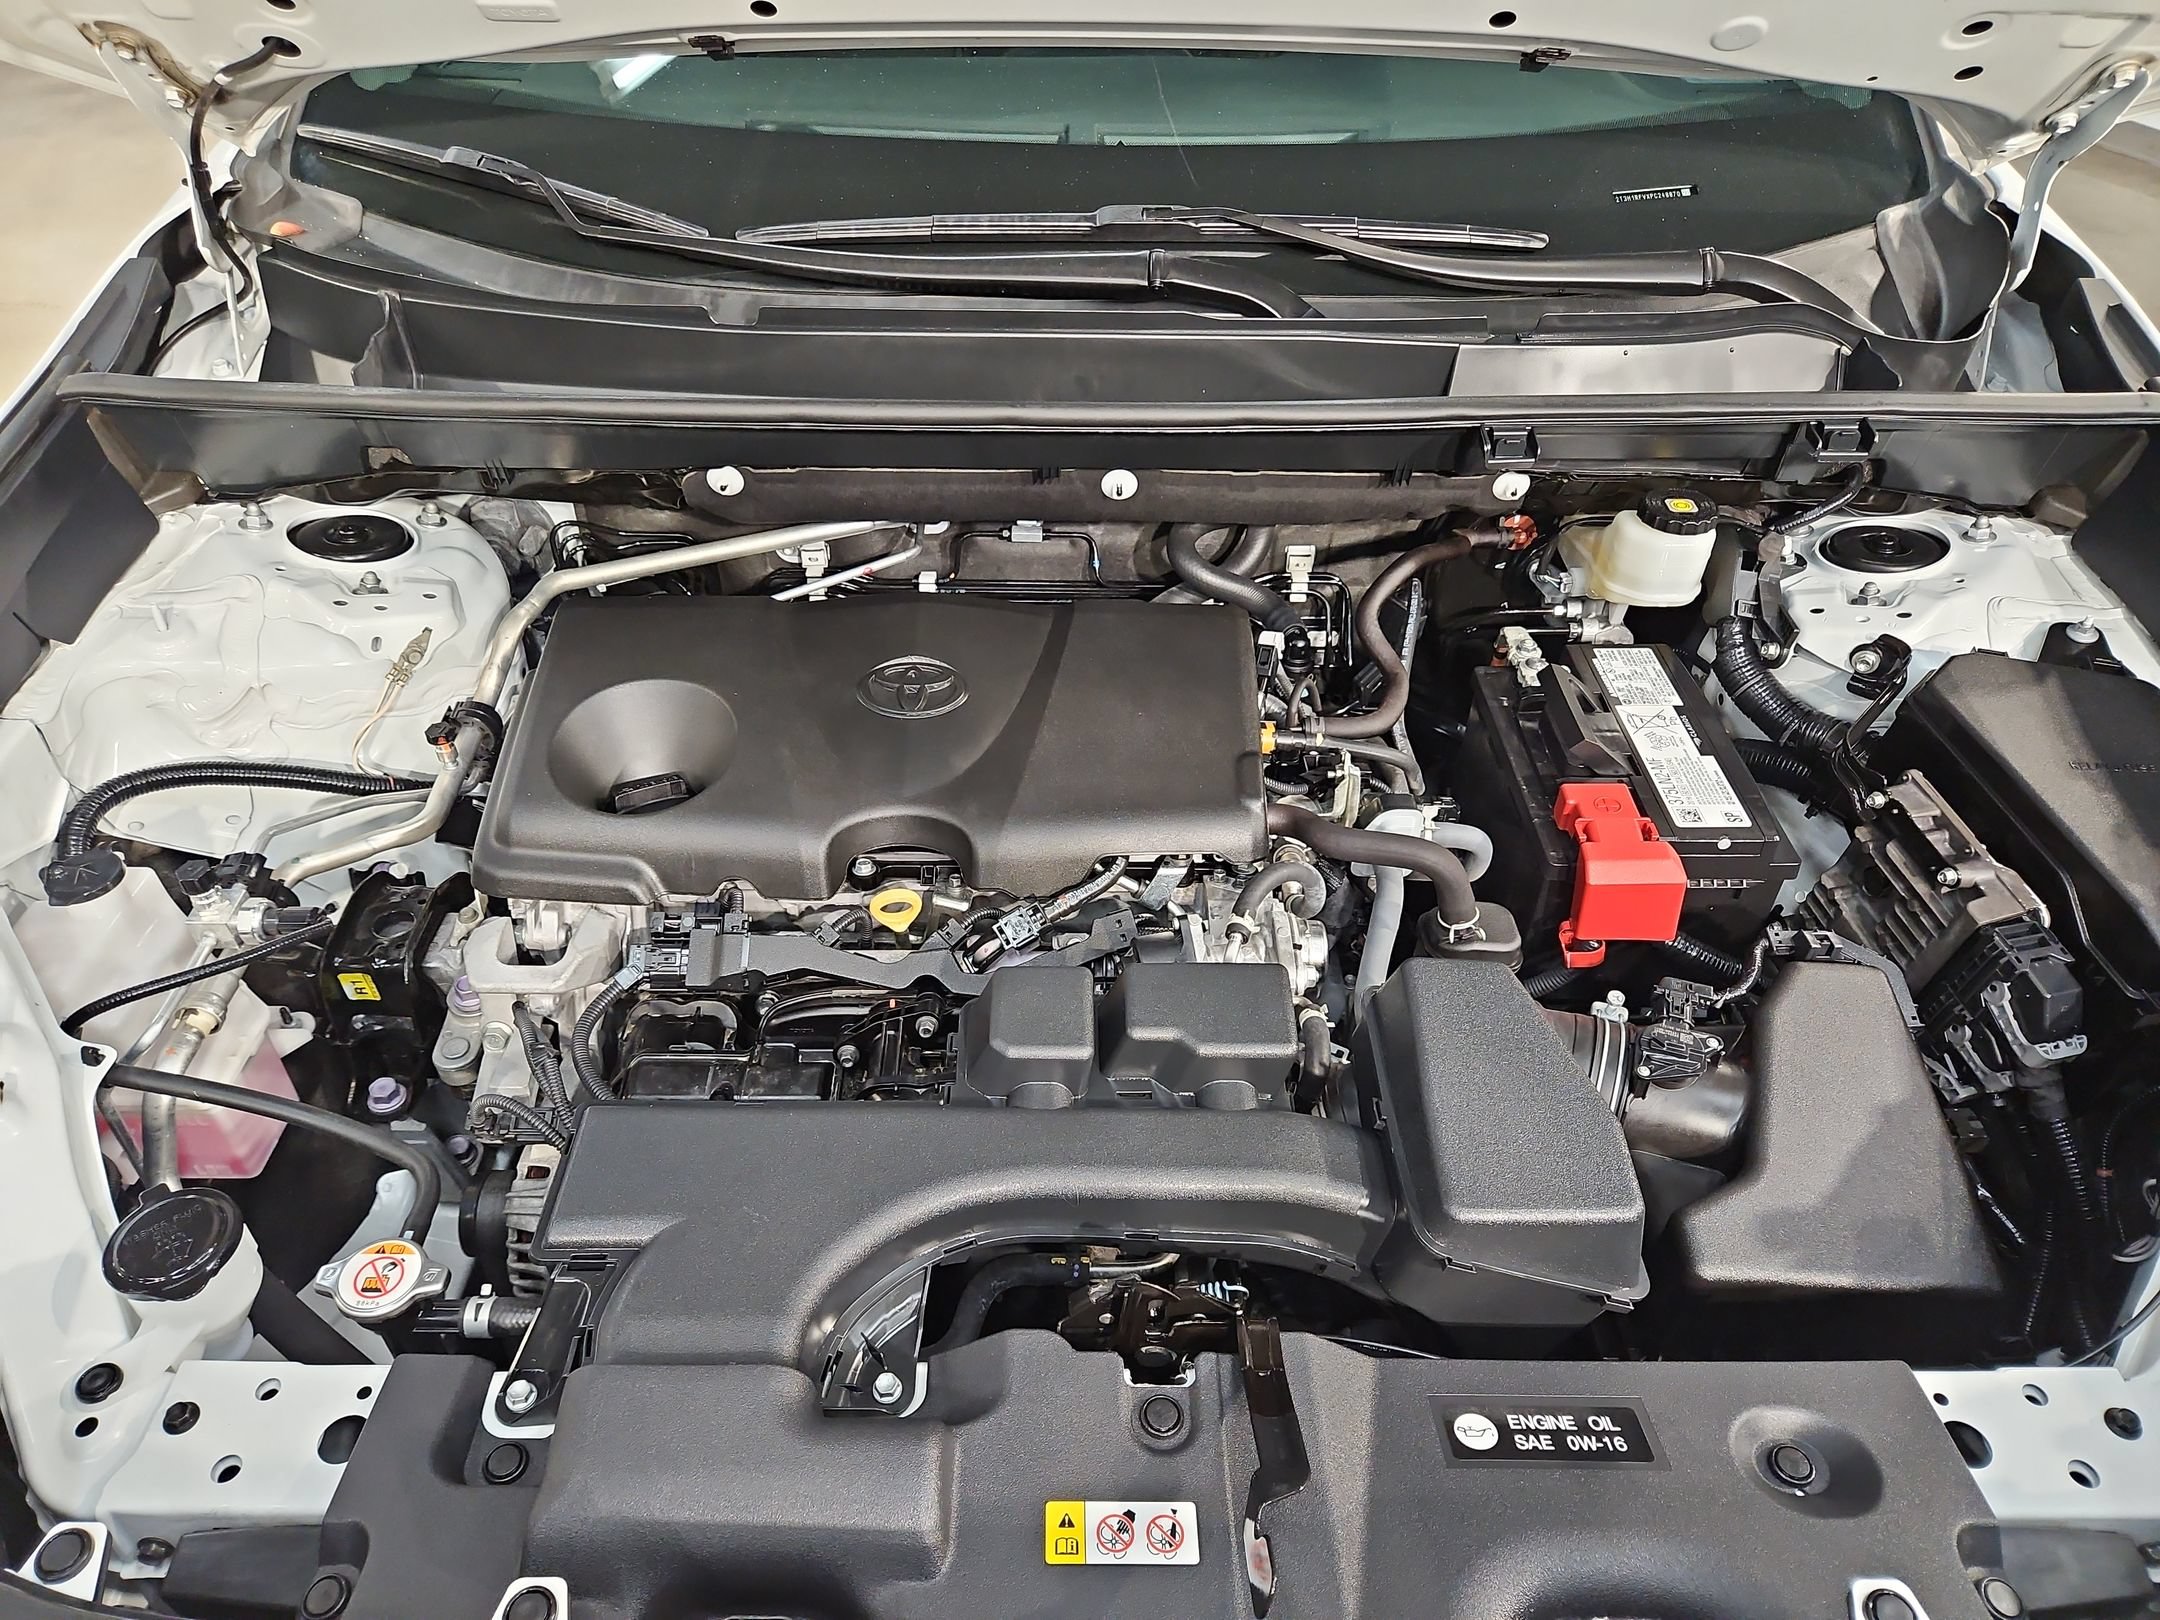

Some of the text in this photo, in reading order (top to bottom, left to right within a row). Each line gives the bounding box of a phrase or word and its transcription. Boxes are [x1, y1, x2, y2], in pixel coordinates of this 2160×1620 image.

[1680, 714, 1697, 738] CLARIOS
[1645, 756, 1685, 805] 375LN2-MF
[1724, 812, 1743, 823] SP
[1506, 1414, 1622, 1432] ENGINE OIL
[1514, 1434, 1628, 1452] SAE 0W-16
